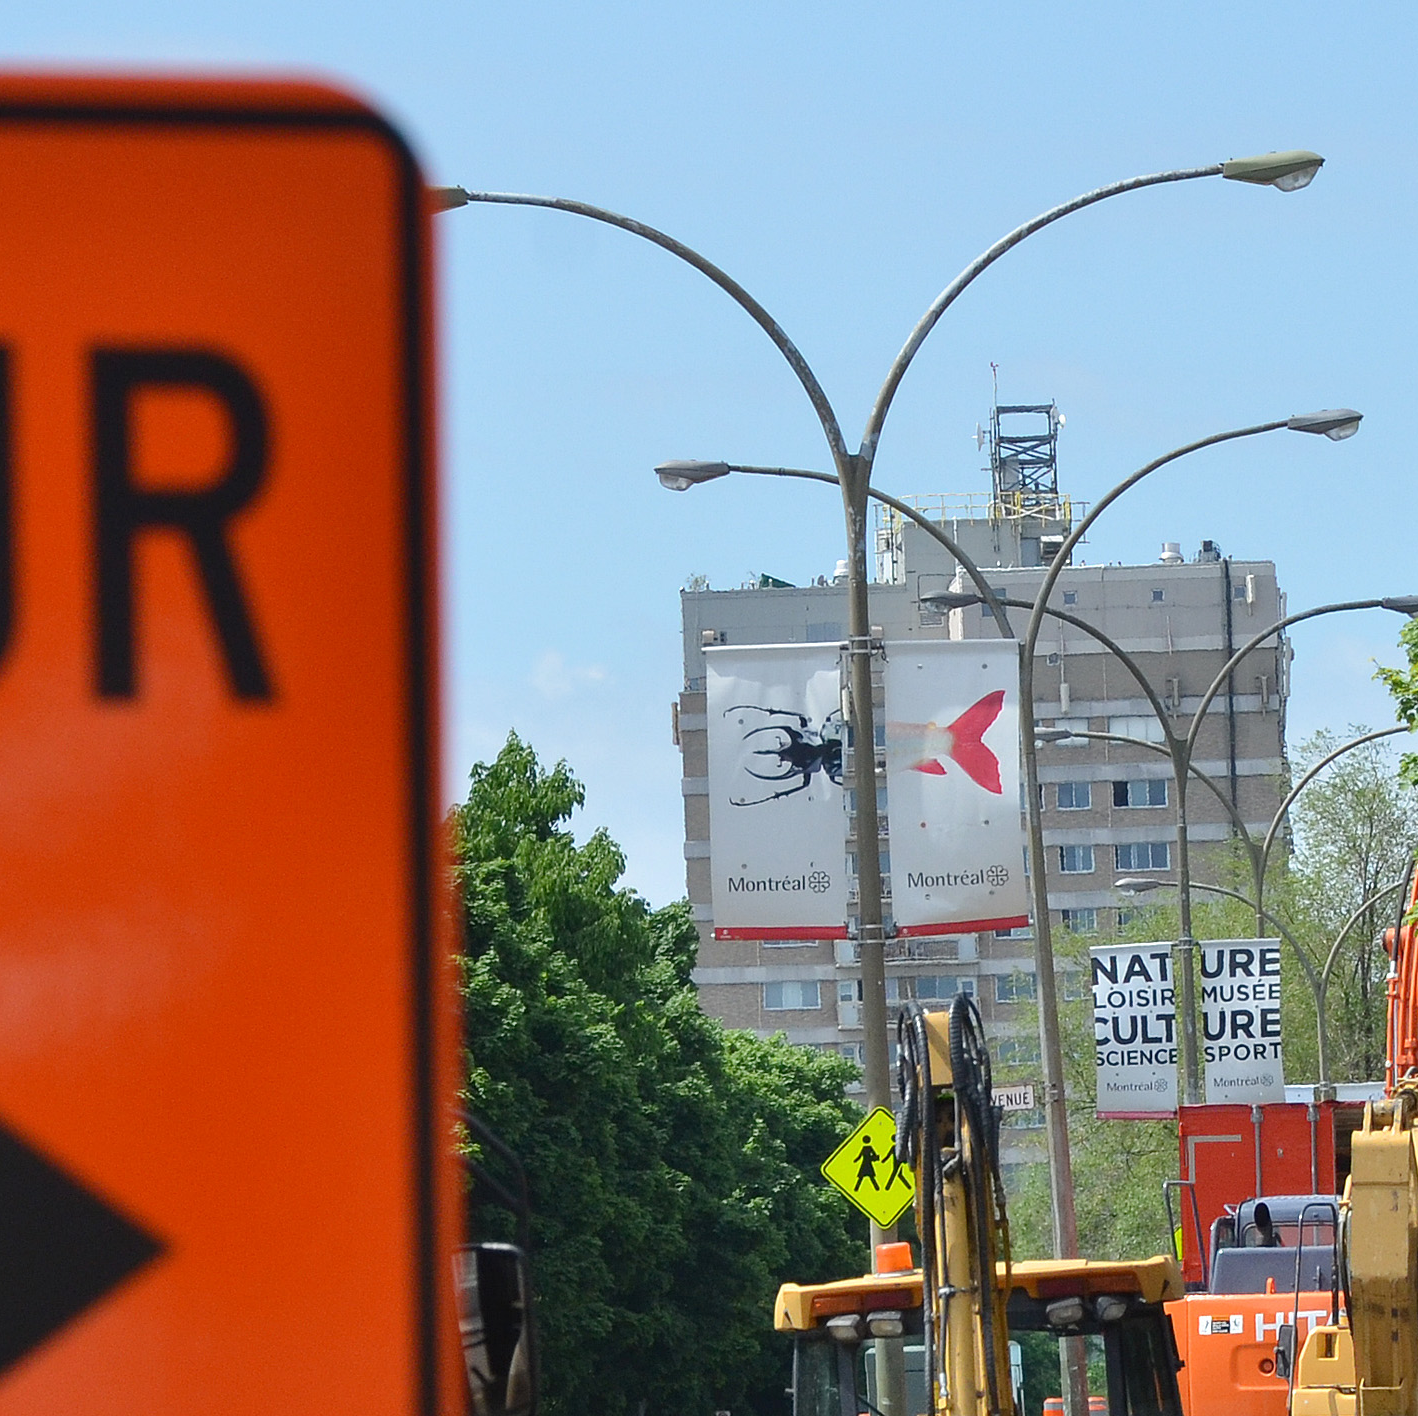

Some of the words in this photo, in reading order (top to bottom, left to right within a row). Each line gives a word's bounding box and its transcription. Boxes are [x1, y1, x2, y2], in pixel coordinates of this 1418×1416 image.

[728, 875, 806, 893] Montréal
[908, 869, 984, 888] Montréal
[1091, 952, 1169, 986] NAT
[1201, 948, 1280, 979] URE
[1094, 988, 1175, 1009] LOISIR
[1202, 979, 1280, 1003] MUSÉE
[1095, 1013, 1176, 1046] CULT
[1203, 1008, 1281, 1041] URE
[1097, 1048, 1177, 1067] SCIENCE
[1205, 1041, 1281, 1063] SPORT
[1107, 1078, 1153, 1092] Montréal
[1213, 1075, 1260, 1088] Montréal
